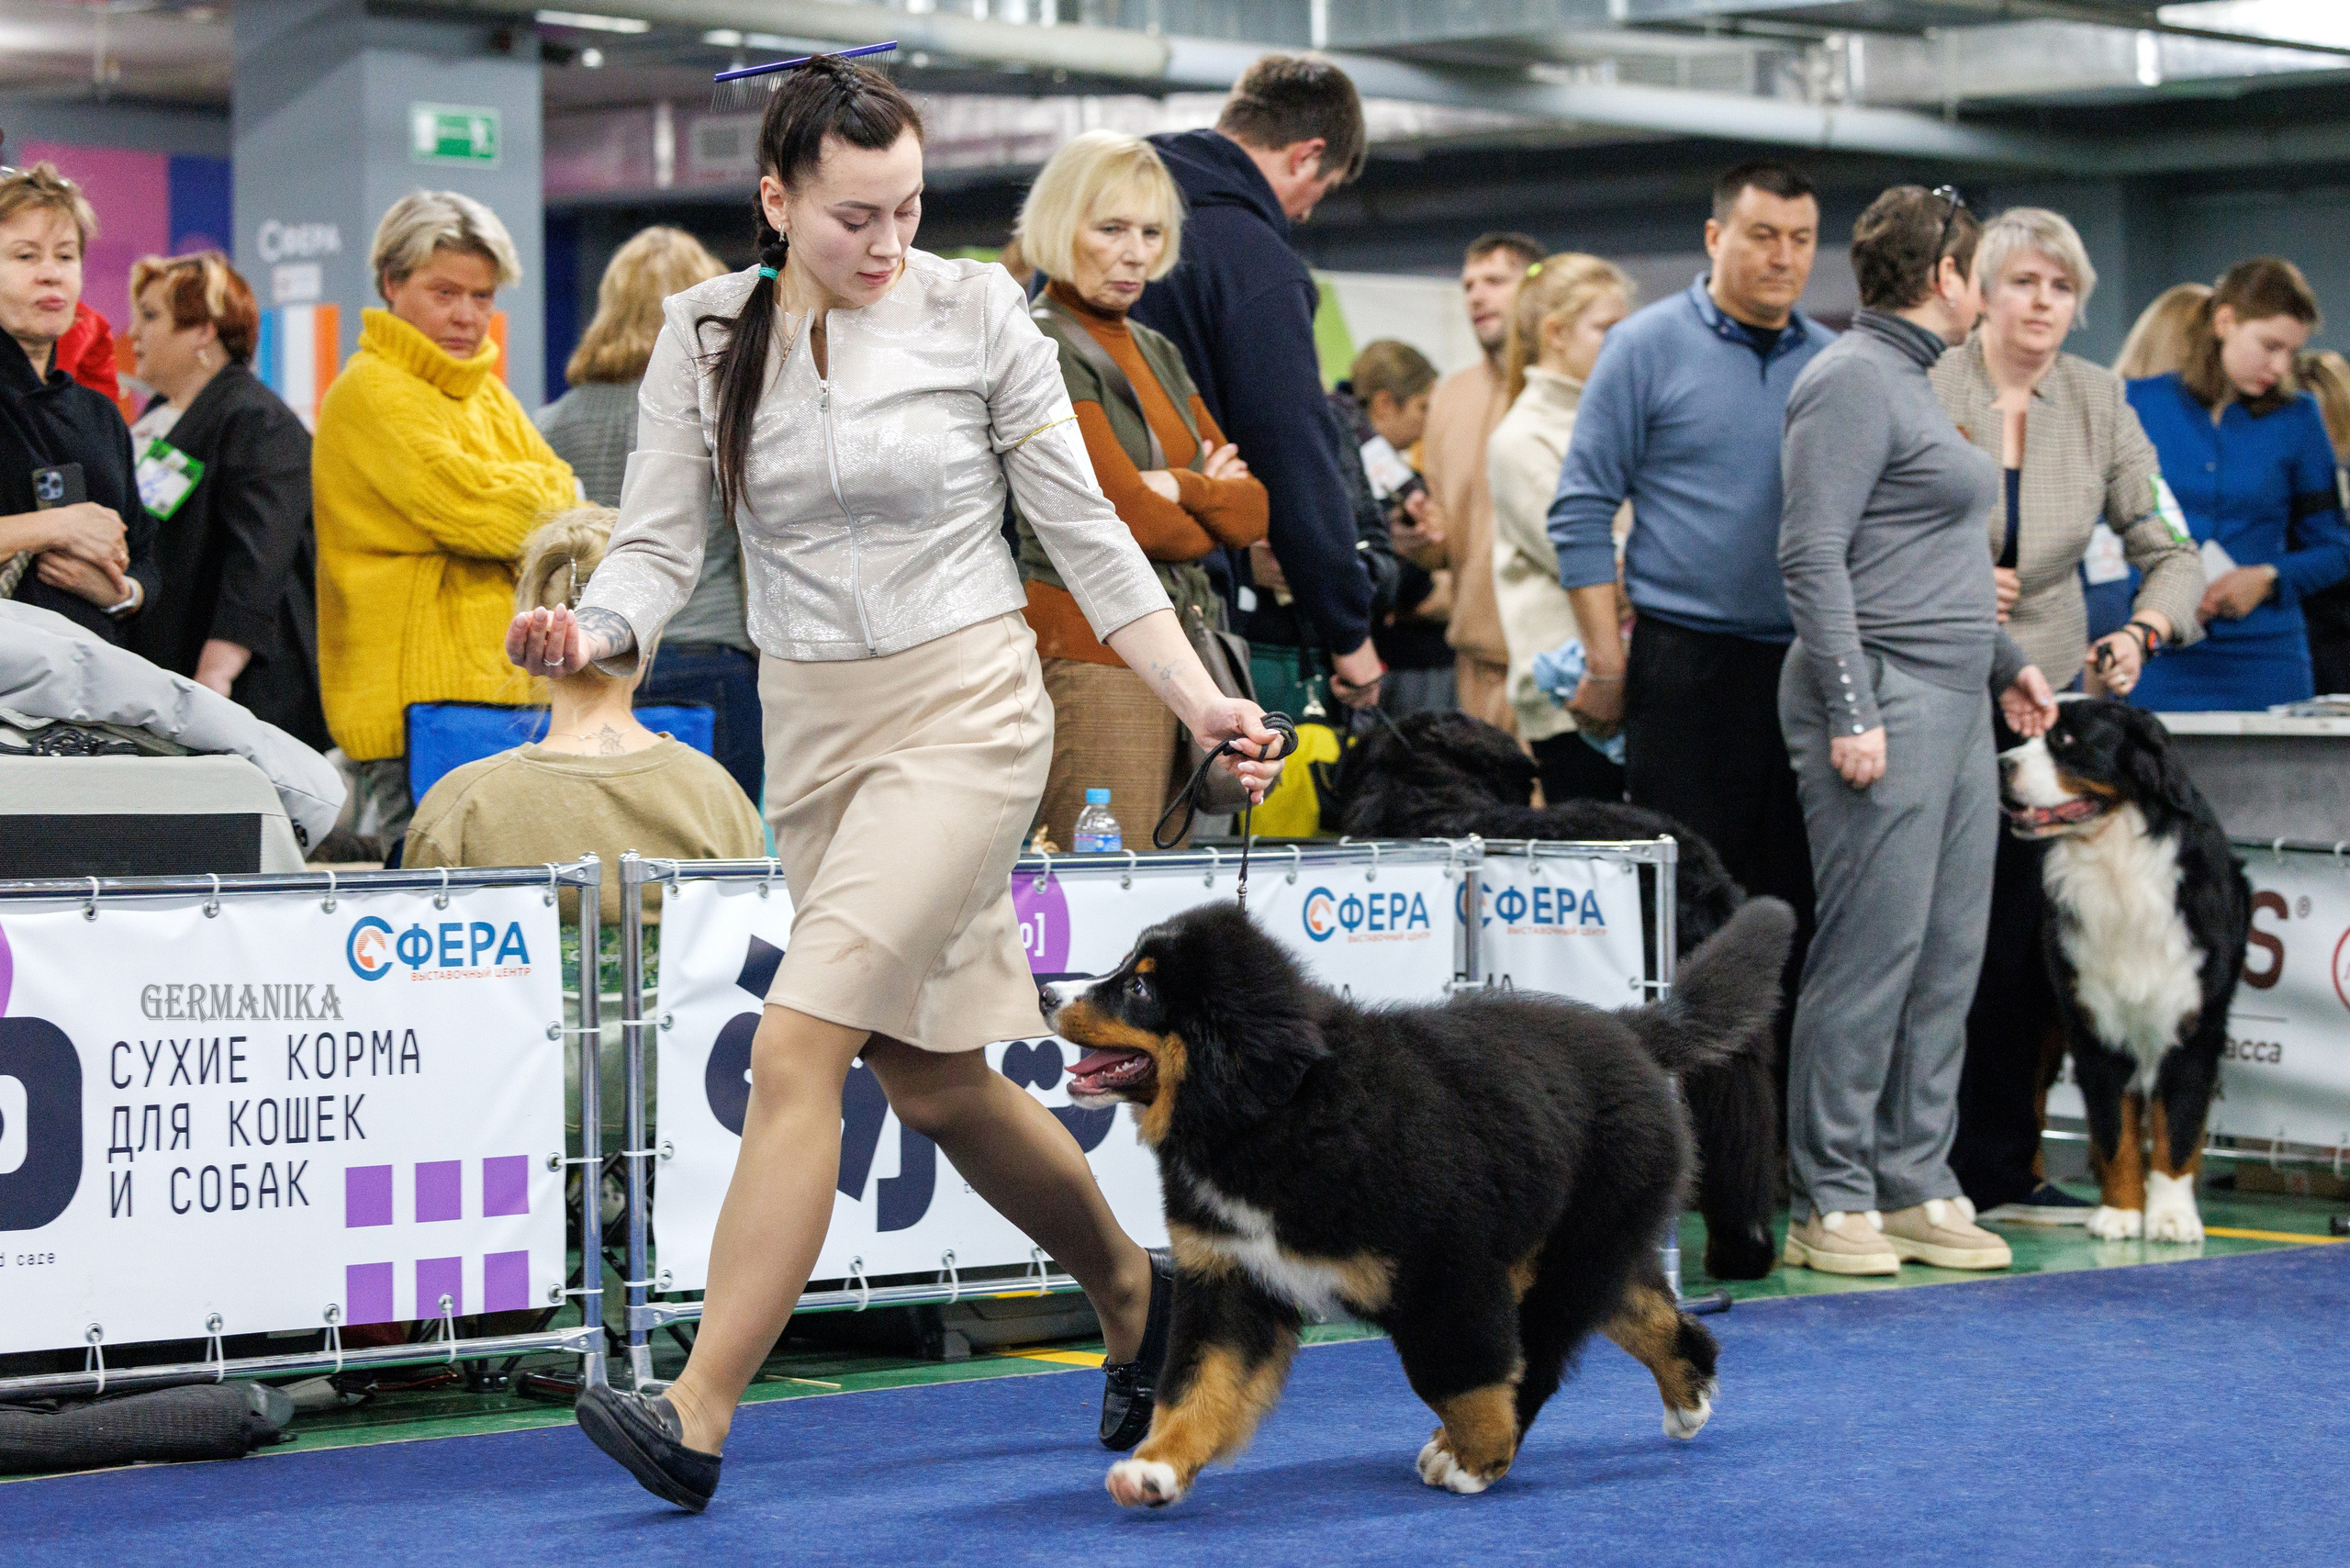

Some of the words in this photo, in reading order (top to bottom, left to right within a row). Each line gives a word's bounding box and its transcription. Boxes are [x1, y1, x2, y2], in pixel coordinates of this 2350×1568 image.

[1302, 885, 1431, 943] СФЕРА
[345, 915, 531, 981] СФЕРА
[410, 969, 493, 981] ВЫСТАВОЧНЫЙ
[494, 967, 532, 979] ЦЕНТР
[111, 1036, 248, 1090] СУХИЕ
[287, 1028, 420, 1081] КОРМА
[107, 1103, 190, 1163] ДЛЯ
[229, 1093, 366, 1147] КОШЕК
[110, 1170, 132, 1218] И
[171, 1159, 310, 1215] СОБАК
[17, 1252, 55, 1267] care
